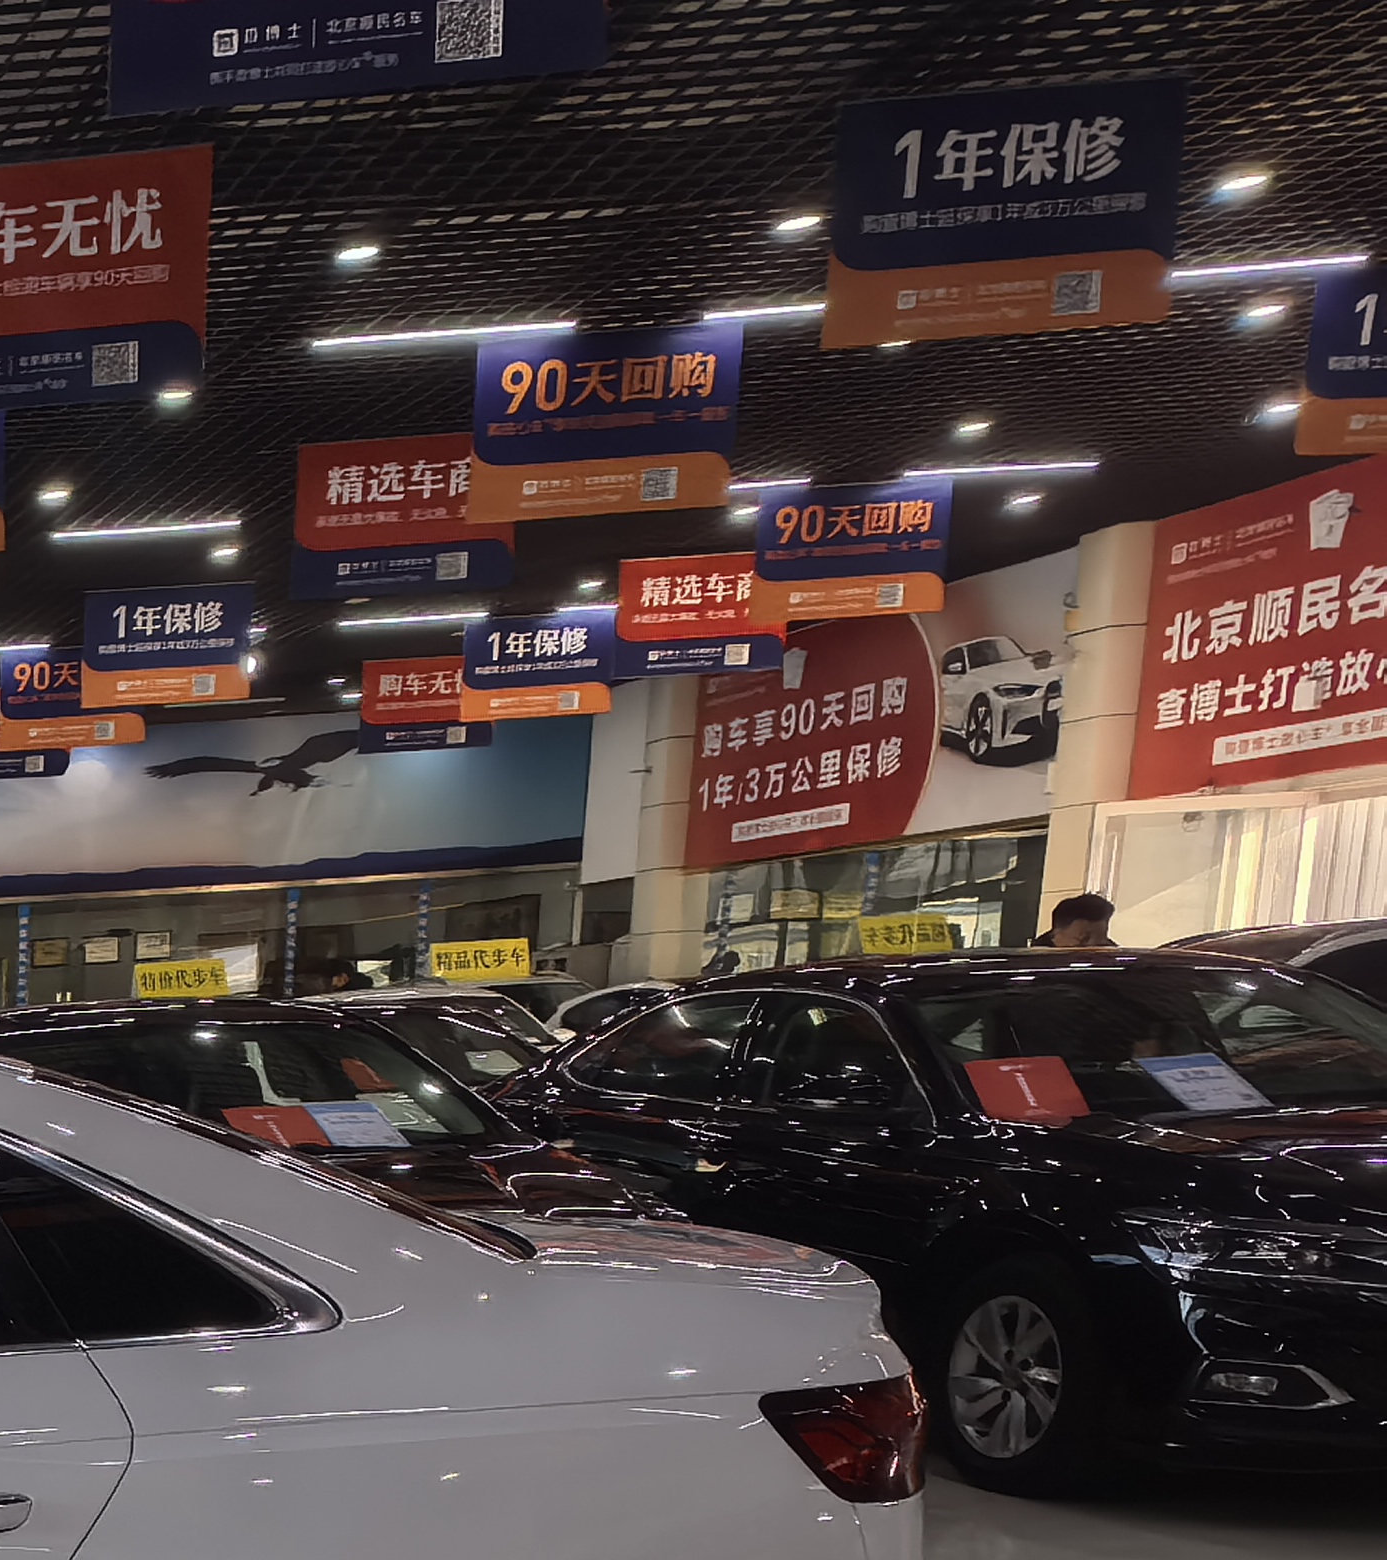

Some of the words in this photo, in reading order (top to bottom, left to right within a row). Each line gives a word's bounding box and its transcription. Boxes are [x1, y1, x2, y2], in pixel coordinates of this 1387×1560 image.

[894, 116, 1125, 199] 1年保修
[1355, 293, 1387, 346] 1
[501, 351, 717, 416] 90天回购
[776, 499, 935, 545] 90天回购
[112, 601, 223, 639] 1年保修
[487, 627, 588, 661] 1年保修
[378, 669, 462, 698] 购车无
[1154, 649, 1387, 730] 查博士打造放
[701, 676, 908, 758] 购车享90天回购
[698, 736, 903, 812] 1年/3万公里保修
